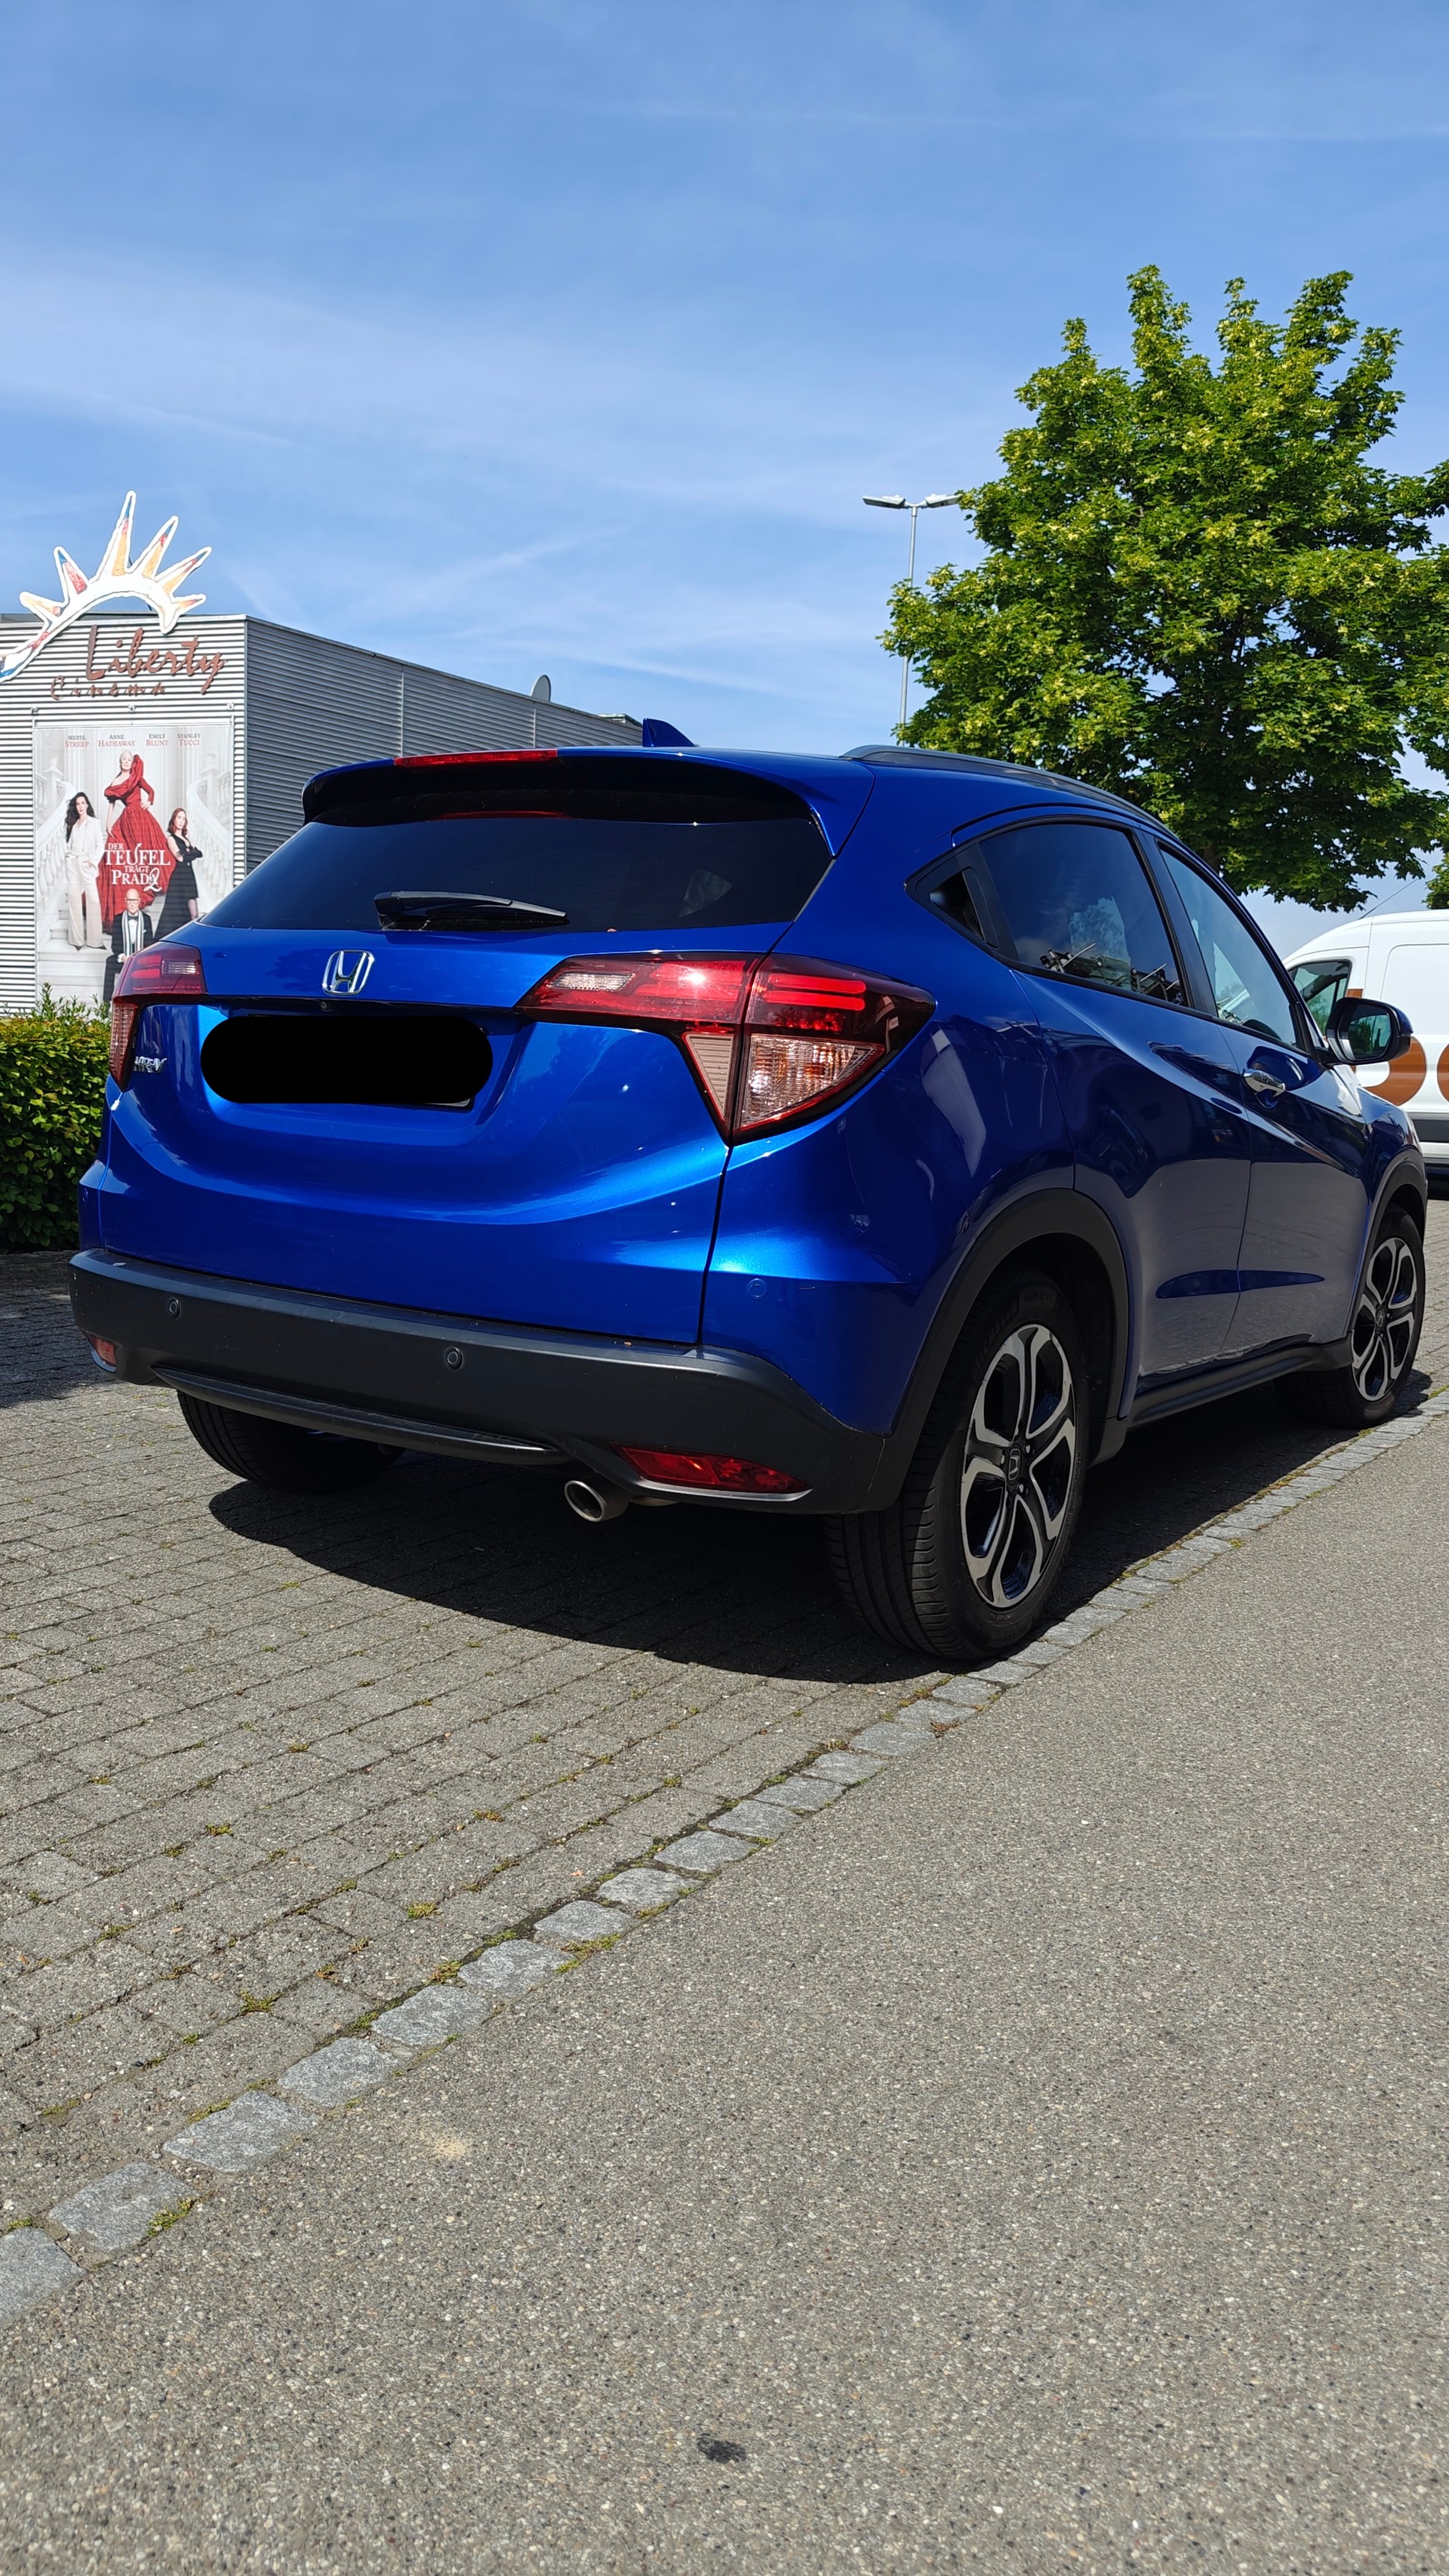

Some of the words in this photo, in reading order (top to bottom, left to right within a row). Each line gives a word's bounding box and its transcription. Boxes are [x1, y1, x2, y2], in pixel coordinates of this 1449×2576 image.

[86, 624, 226, 695] Liberty
[51, 676, 165, 700] Cinema
[104, 842, 171, 866] TEUFEL
[111, 869, 158, 885] PRADA
